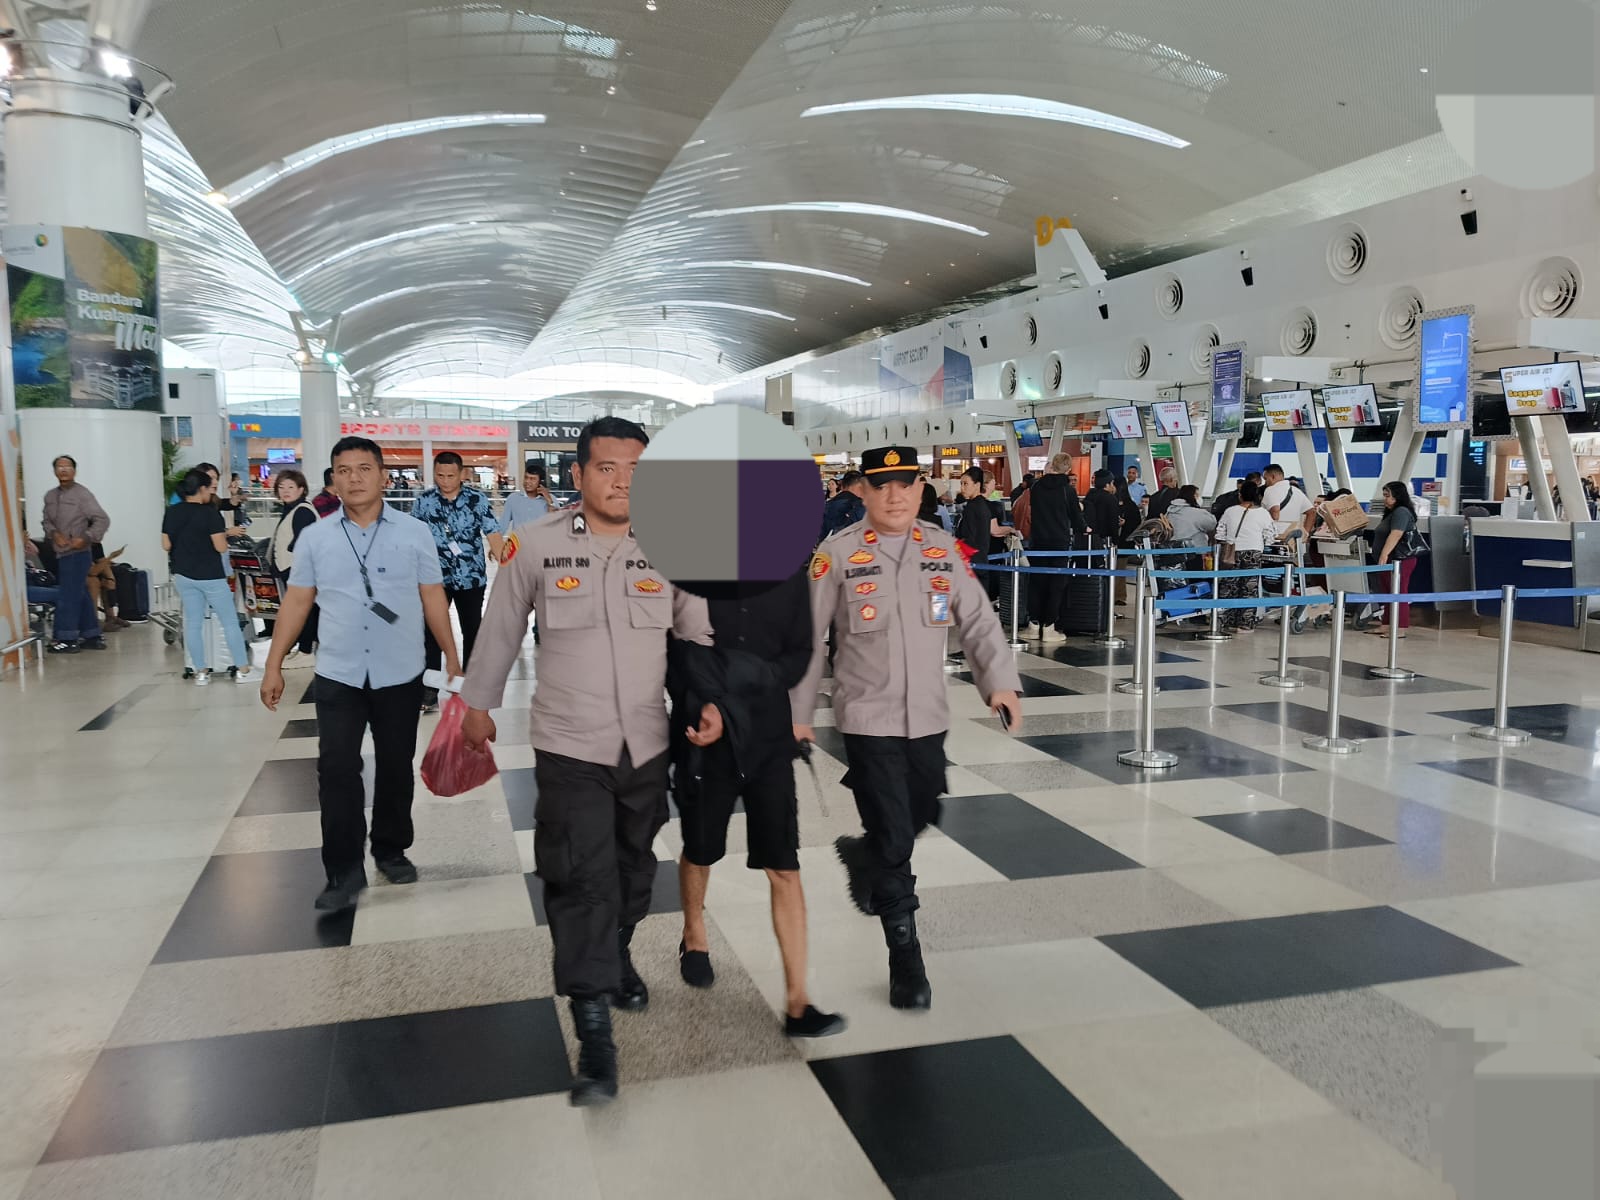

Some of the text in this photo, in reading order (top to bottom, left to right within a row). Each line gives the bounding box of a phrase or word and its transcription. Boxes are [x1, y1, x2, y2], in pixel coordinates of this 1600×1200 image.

[77, 289, 142, 308] Bandara
[1504, 368, 1528, 383] SUPER
[340, 423, 509, 436] SPORTS STATION
[529, 426, 583, 437] KOK TO
[975, 444, 1003, 455] Napoleon
[920, 562, 953, 572] POLRI
